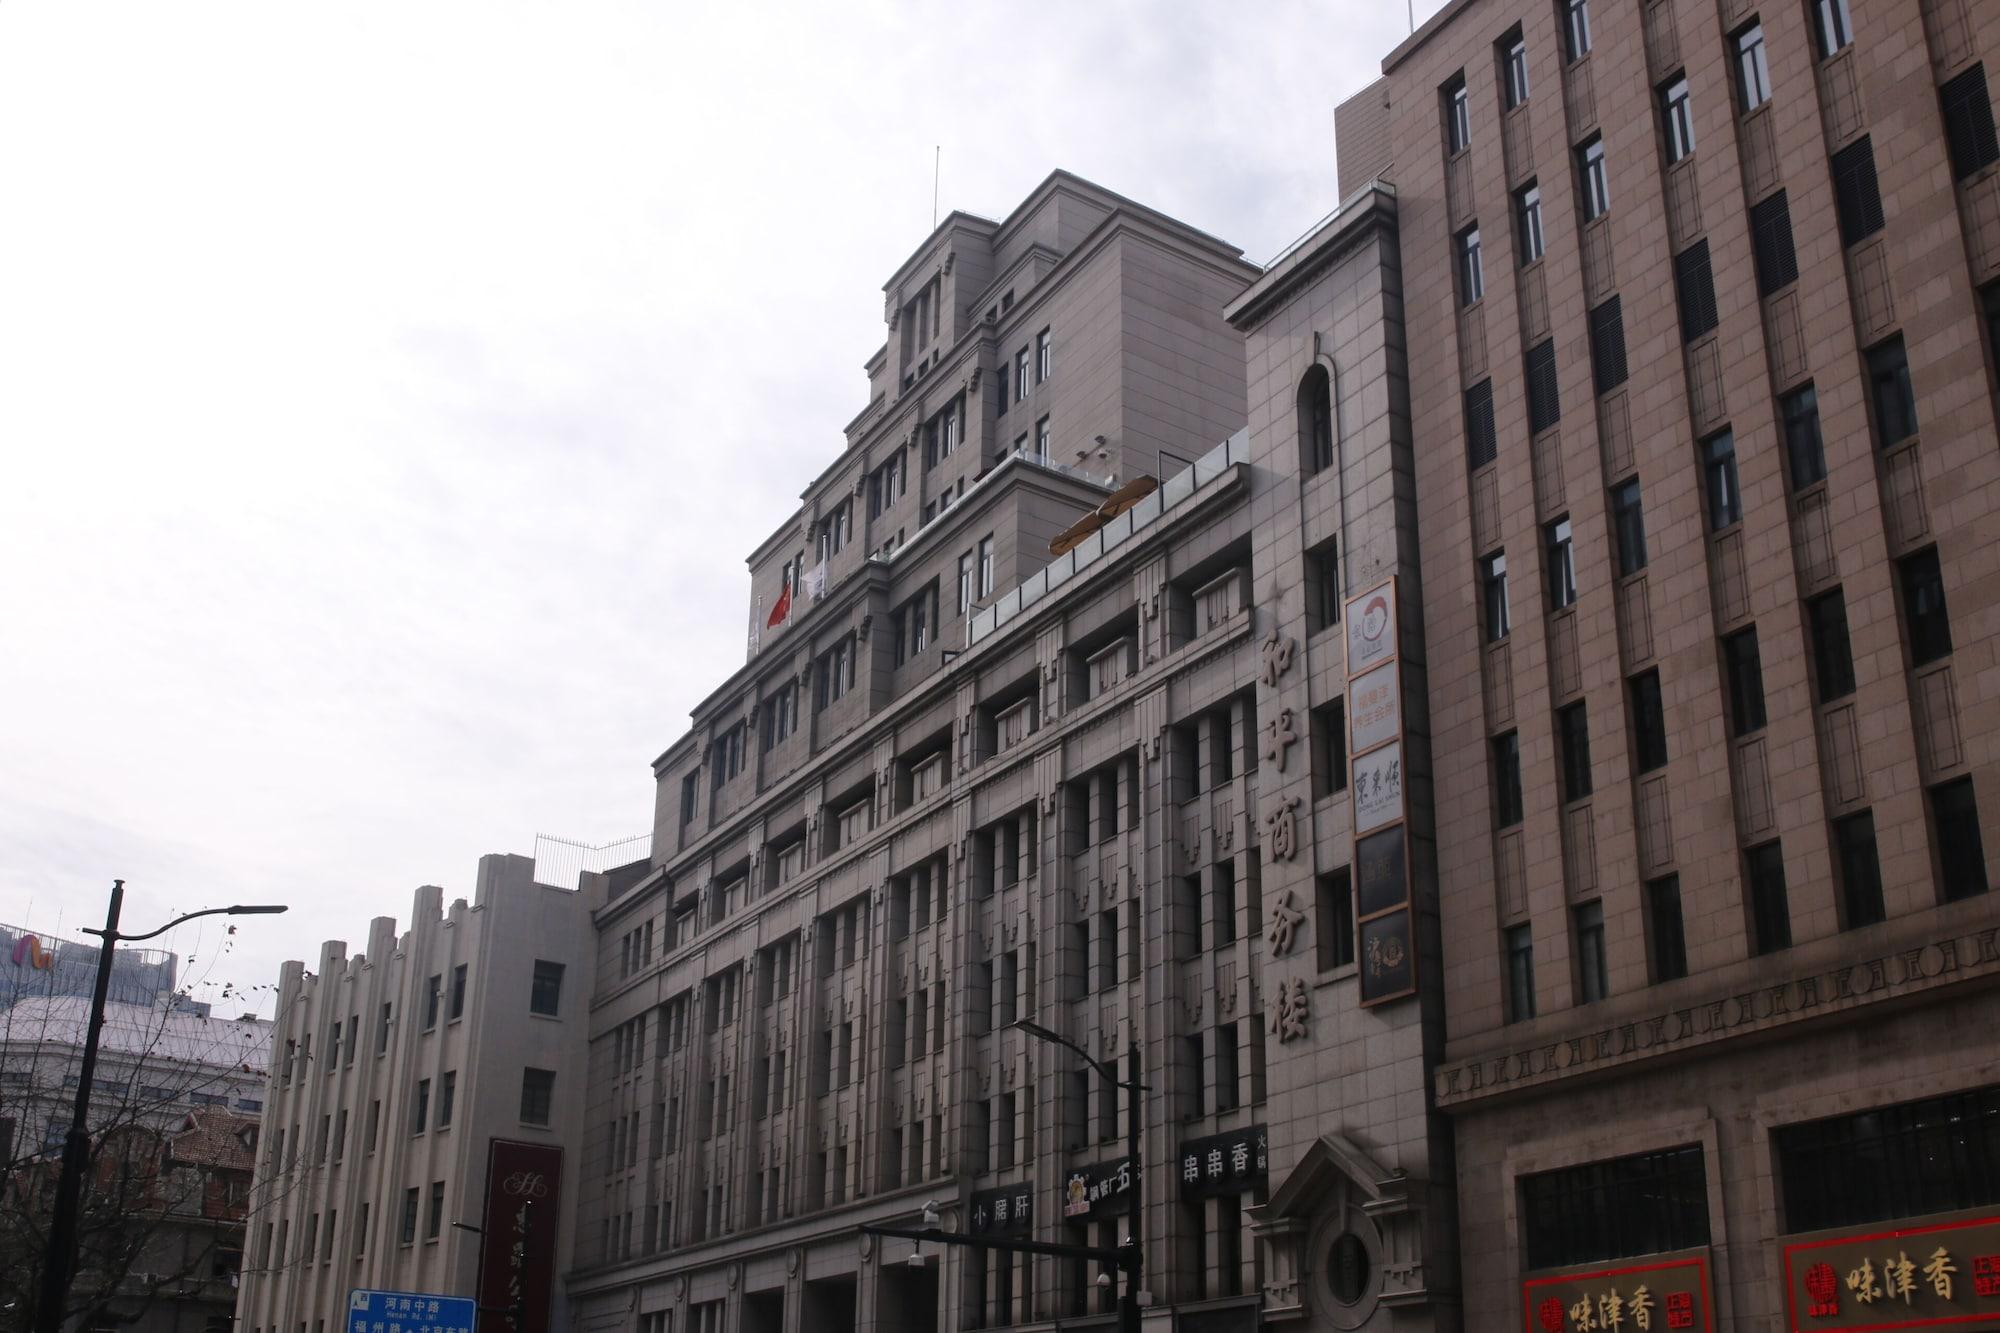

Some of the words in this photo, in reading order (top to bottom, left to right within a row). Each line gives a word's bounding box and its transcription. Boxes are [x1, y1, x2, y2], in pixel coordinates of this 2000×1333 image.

[1261, 628, 1308, 1044] 和平商务楼
[1184, 1142, 1248, 1182] 串串香
[1845, 1247, 1957, 1306] 味津香
[355, 1320, 401, 1333] 福州路
[385, 1297, 440, 1314] 河南中路
[1569, 1284, 1656, 1333] 味津香
